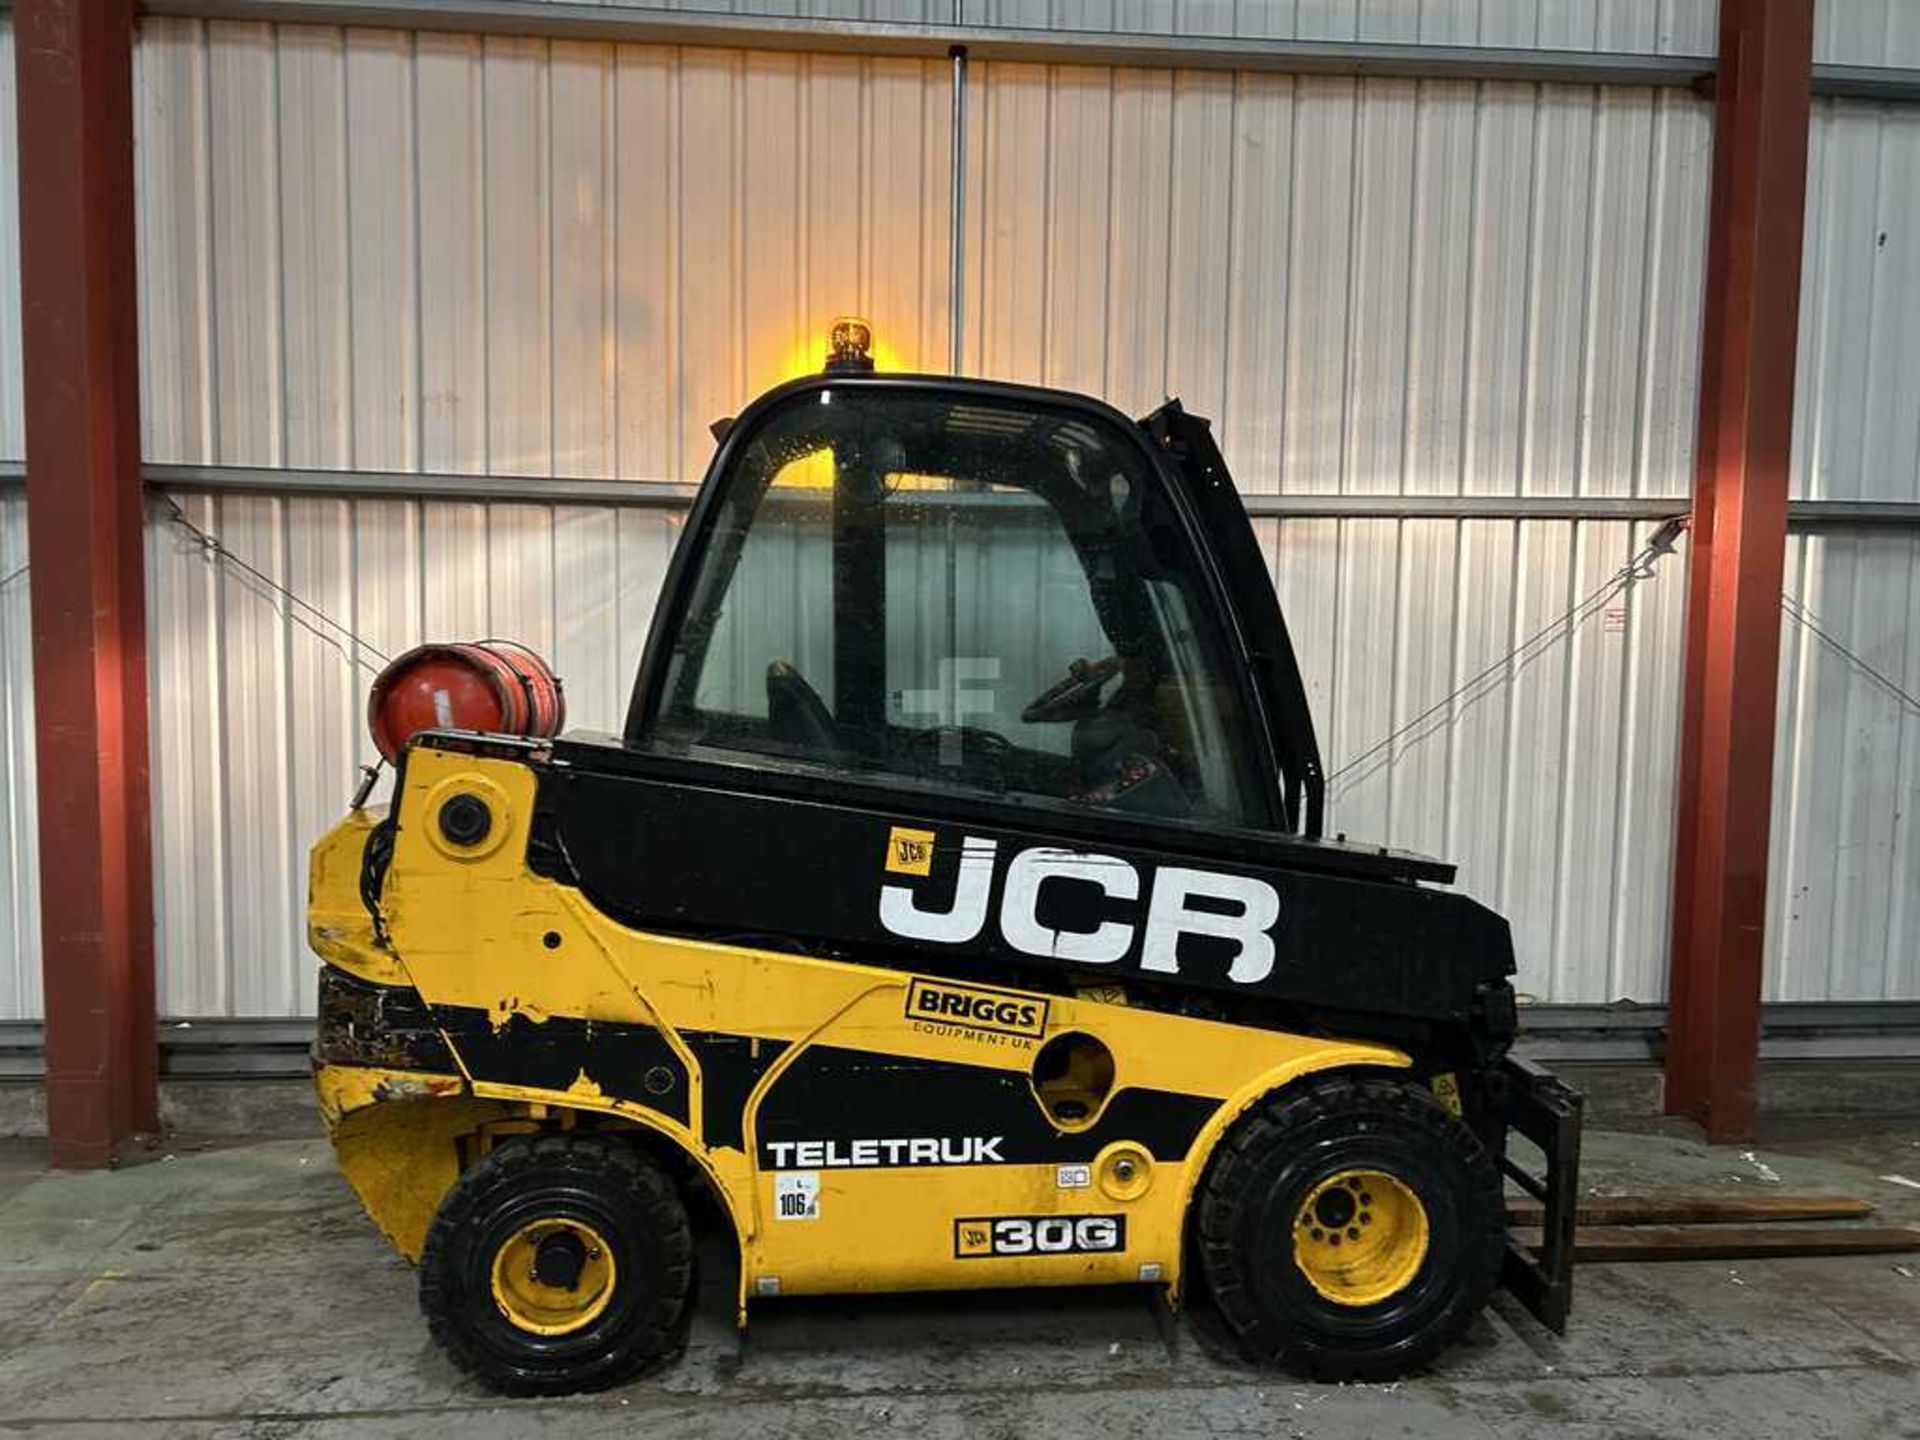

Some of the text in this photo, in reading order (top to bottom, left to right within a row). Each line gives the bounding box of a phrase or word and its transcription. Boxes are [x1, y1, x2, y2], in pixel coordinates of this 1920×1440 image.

[918, 989, 1037, 1028] BRIGGS
[912, 1021, 1033, 1050] EQUIPMENT UK
[767, 1137, 1004, 1167] TELETRUK
[779, 1193, 805, 1216] 106
[994, 1218, 1118, 1253] 30G
